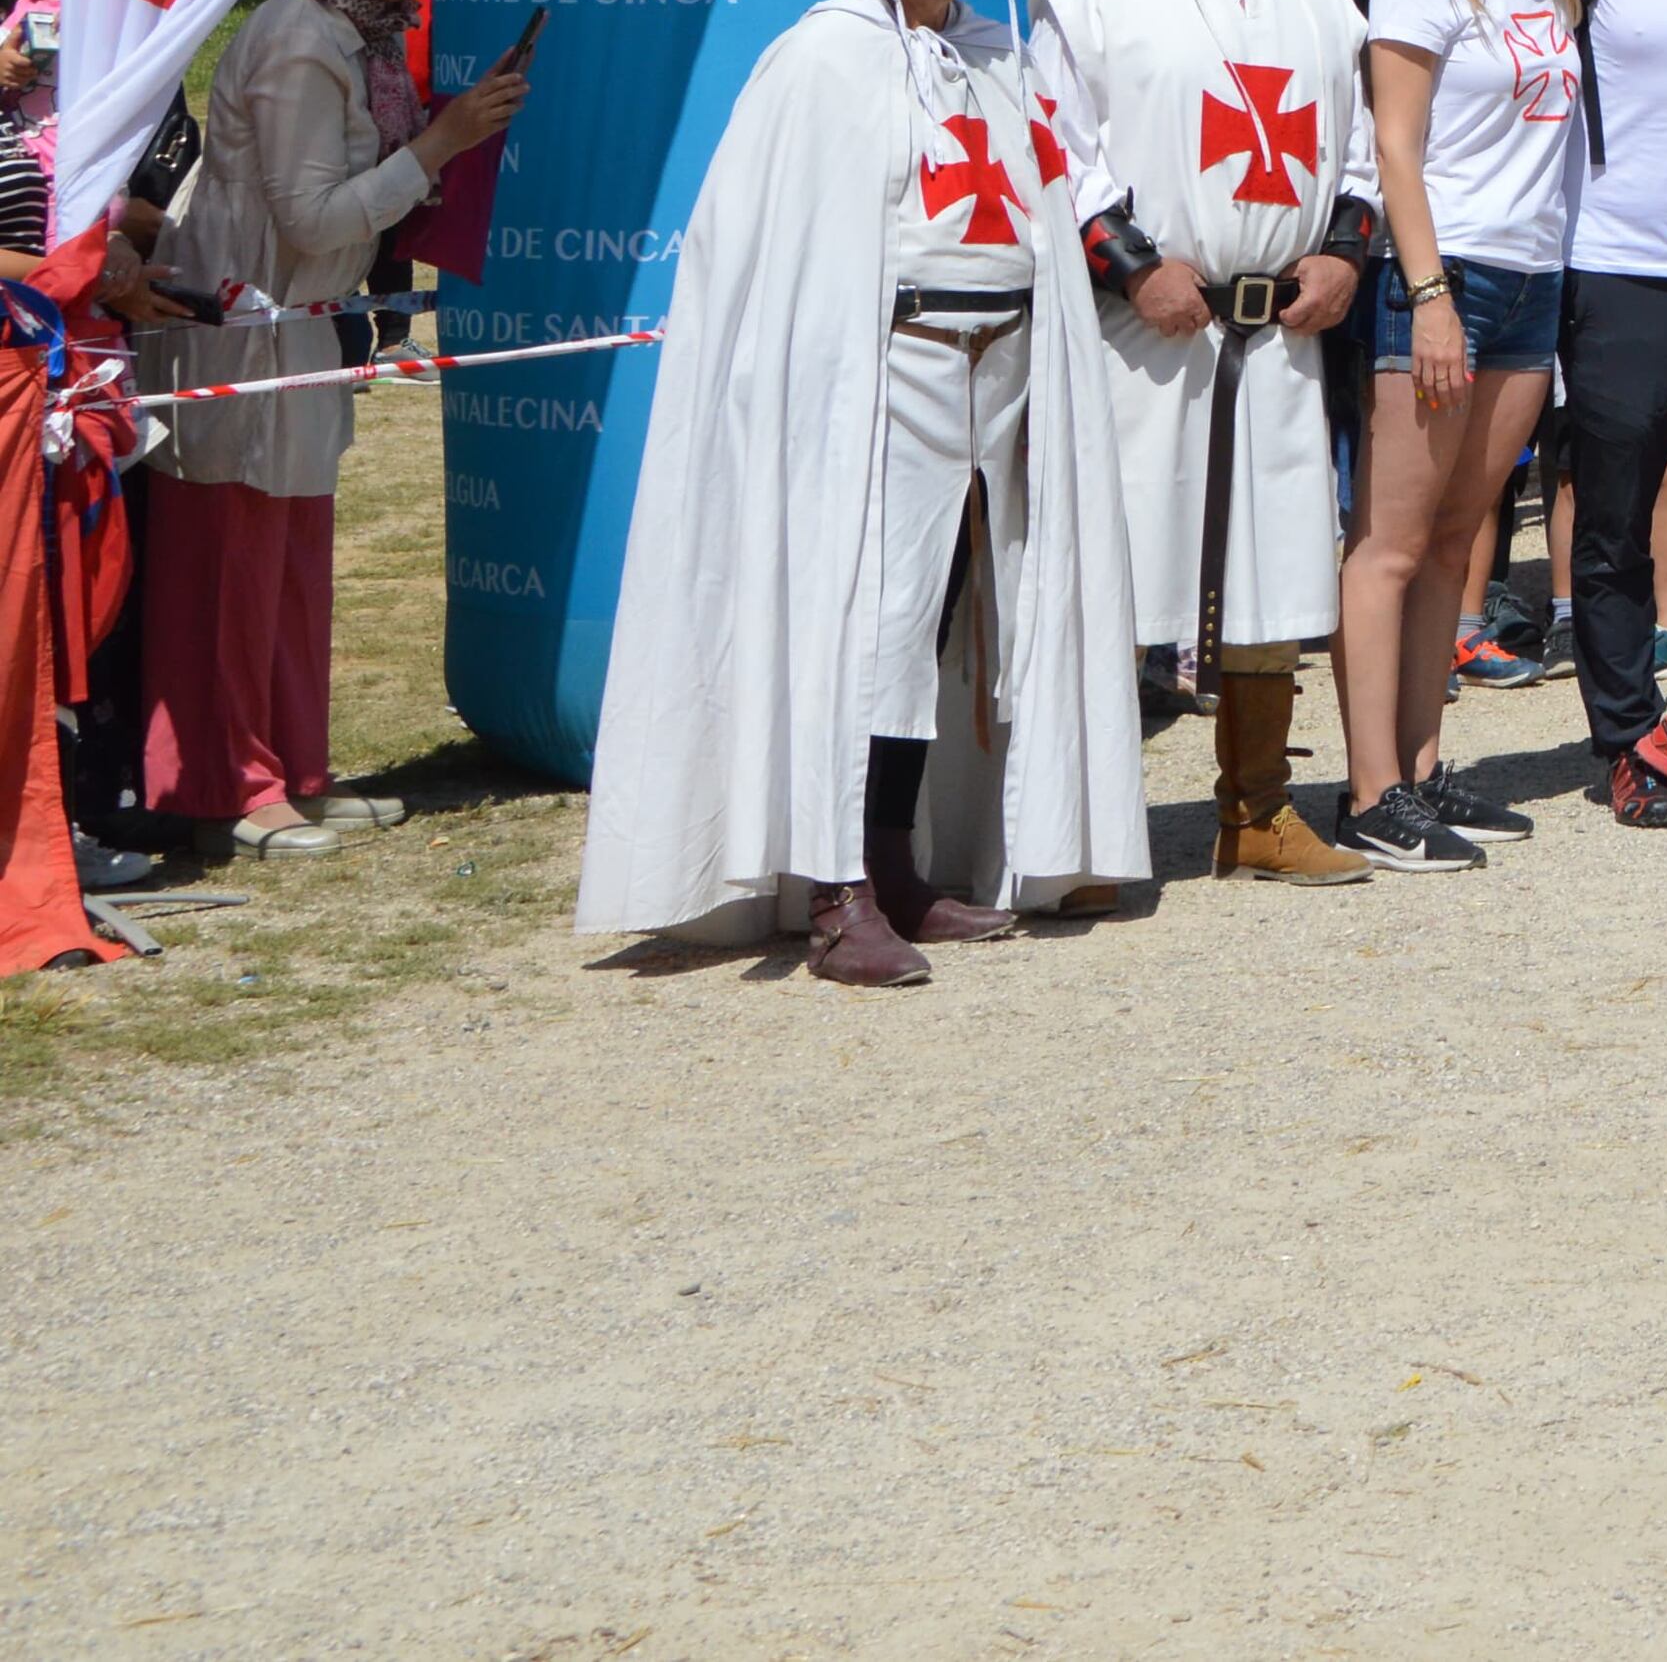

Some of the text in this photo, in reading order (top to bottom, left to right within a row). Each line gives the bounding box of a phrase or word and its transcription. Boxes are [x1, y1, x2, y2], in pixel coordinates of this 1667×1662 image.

[434, 55, 477, 87] FONZ
[501, 228, 544, 260] DE
[438, 309, 485, 340] UEYO
[493, 311, 533, 343] DE
[447, 558, 546, 598] LCARCA
